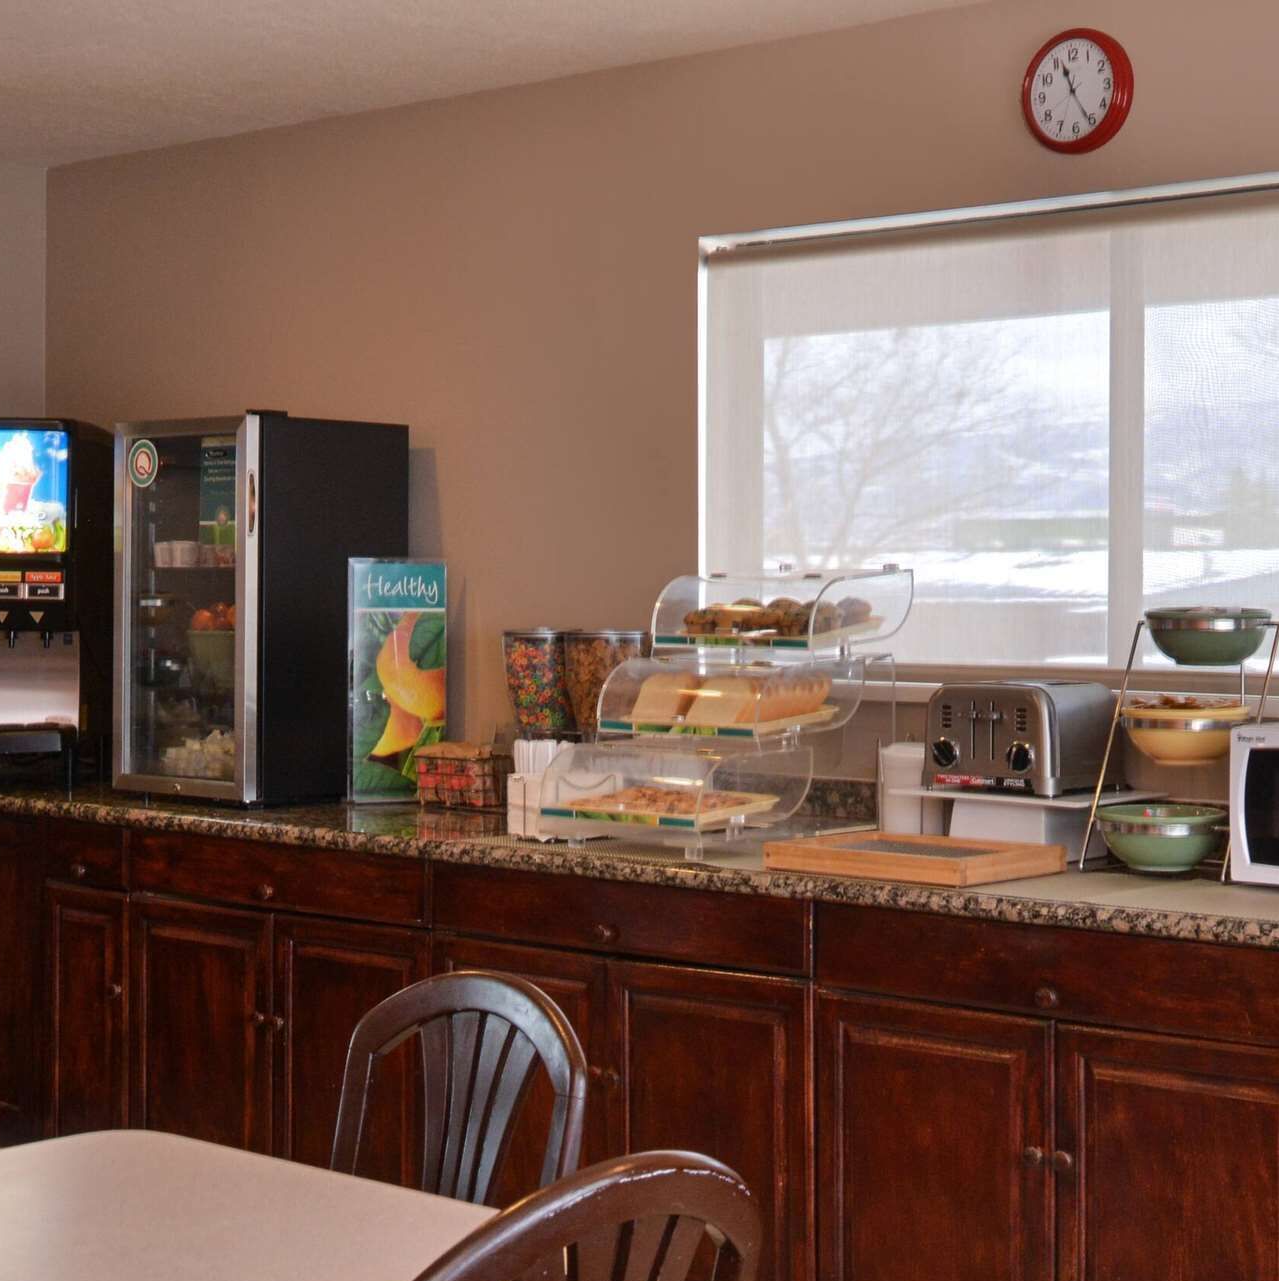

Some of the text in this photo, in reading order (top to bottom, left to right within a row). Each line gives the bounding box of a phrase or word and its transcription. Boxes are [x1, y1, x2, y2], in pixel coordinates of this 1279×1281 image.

[1067, 48, 1079, 62] 12
[1053, 57, 1060, 71] 11
[1097, 60, 1106, 73] 2
[1042, 73, 1054, 87] 10
[1103, 78, 1111, 90] 3
[1038, 92, 1046, 104] 9
[1099, 97, 1107, 110] 4
[1044, 109, 1052, 121] 8
[1056, 120, 1064, 133] 7
[1072, 121, 1080, 134] 6
[362, 572, 438, 605] Healthy
